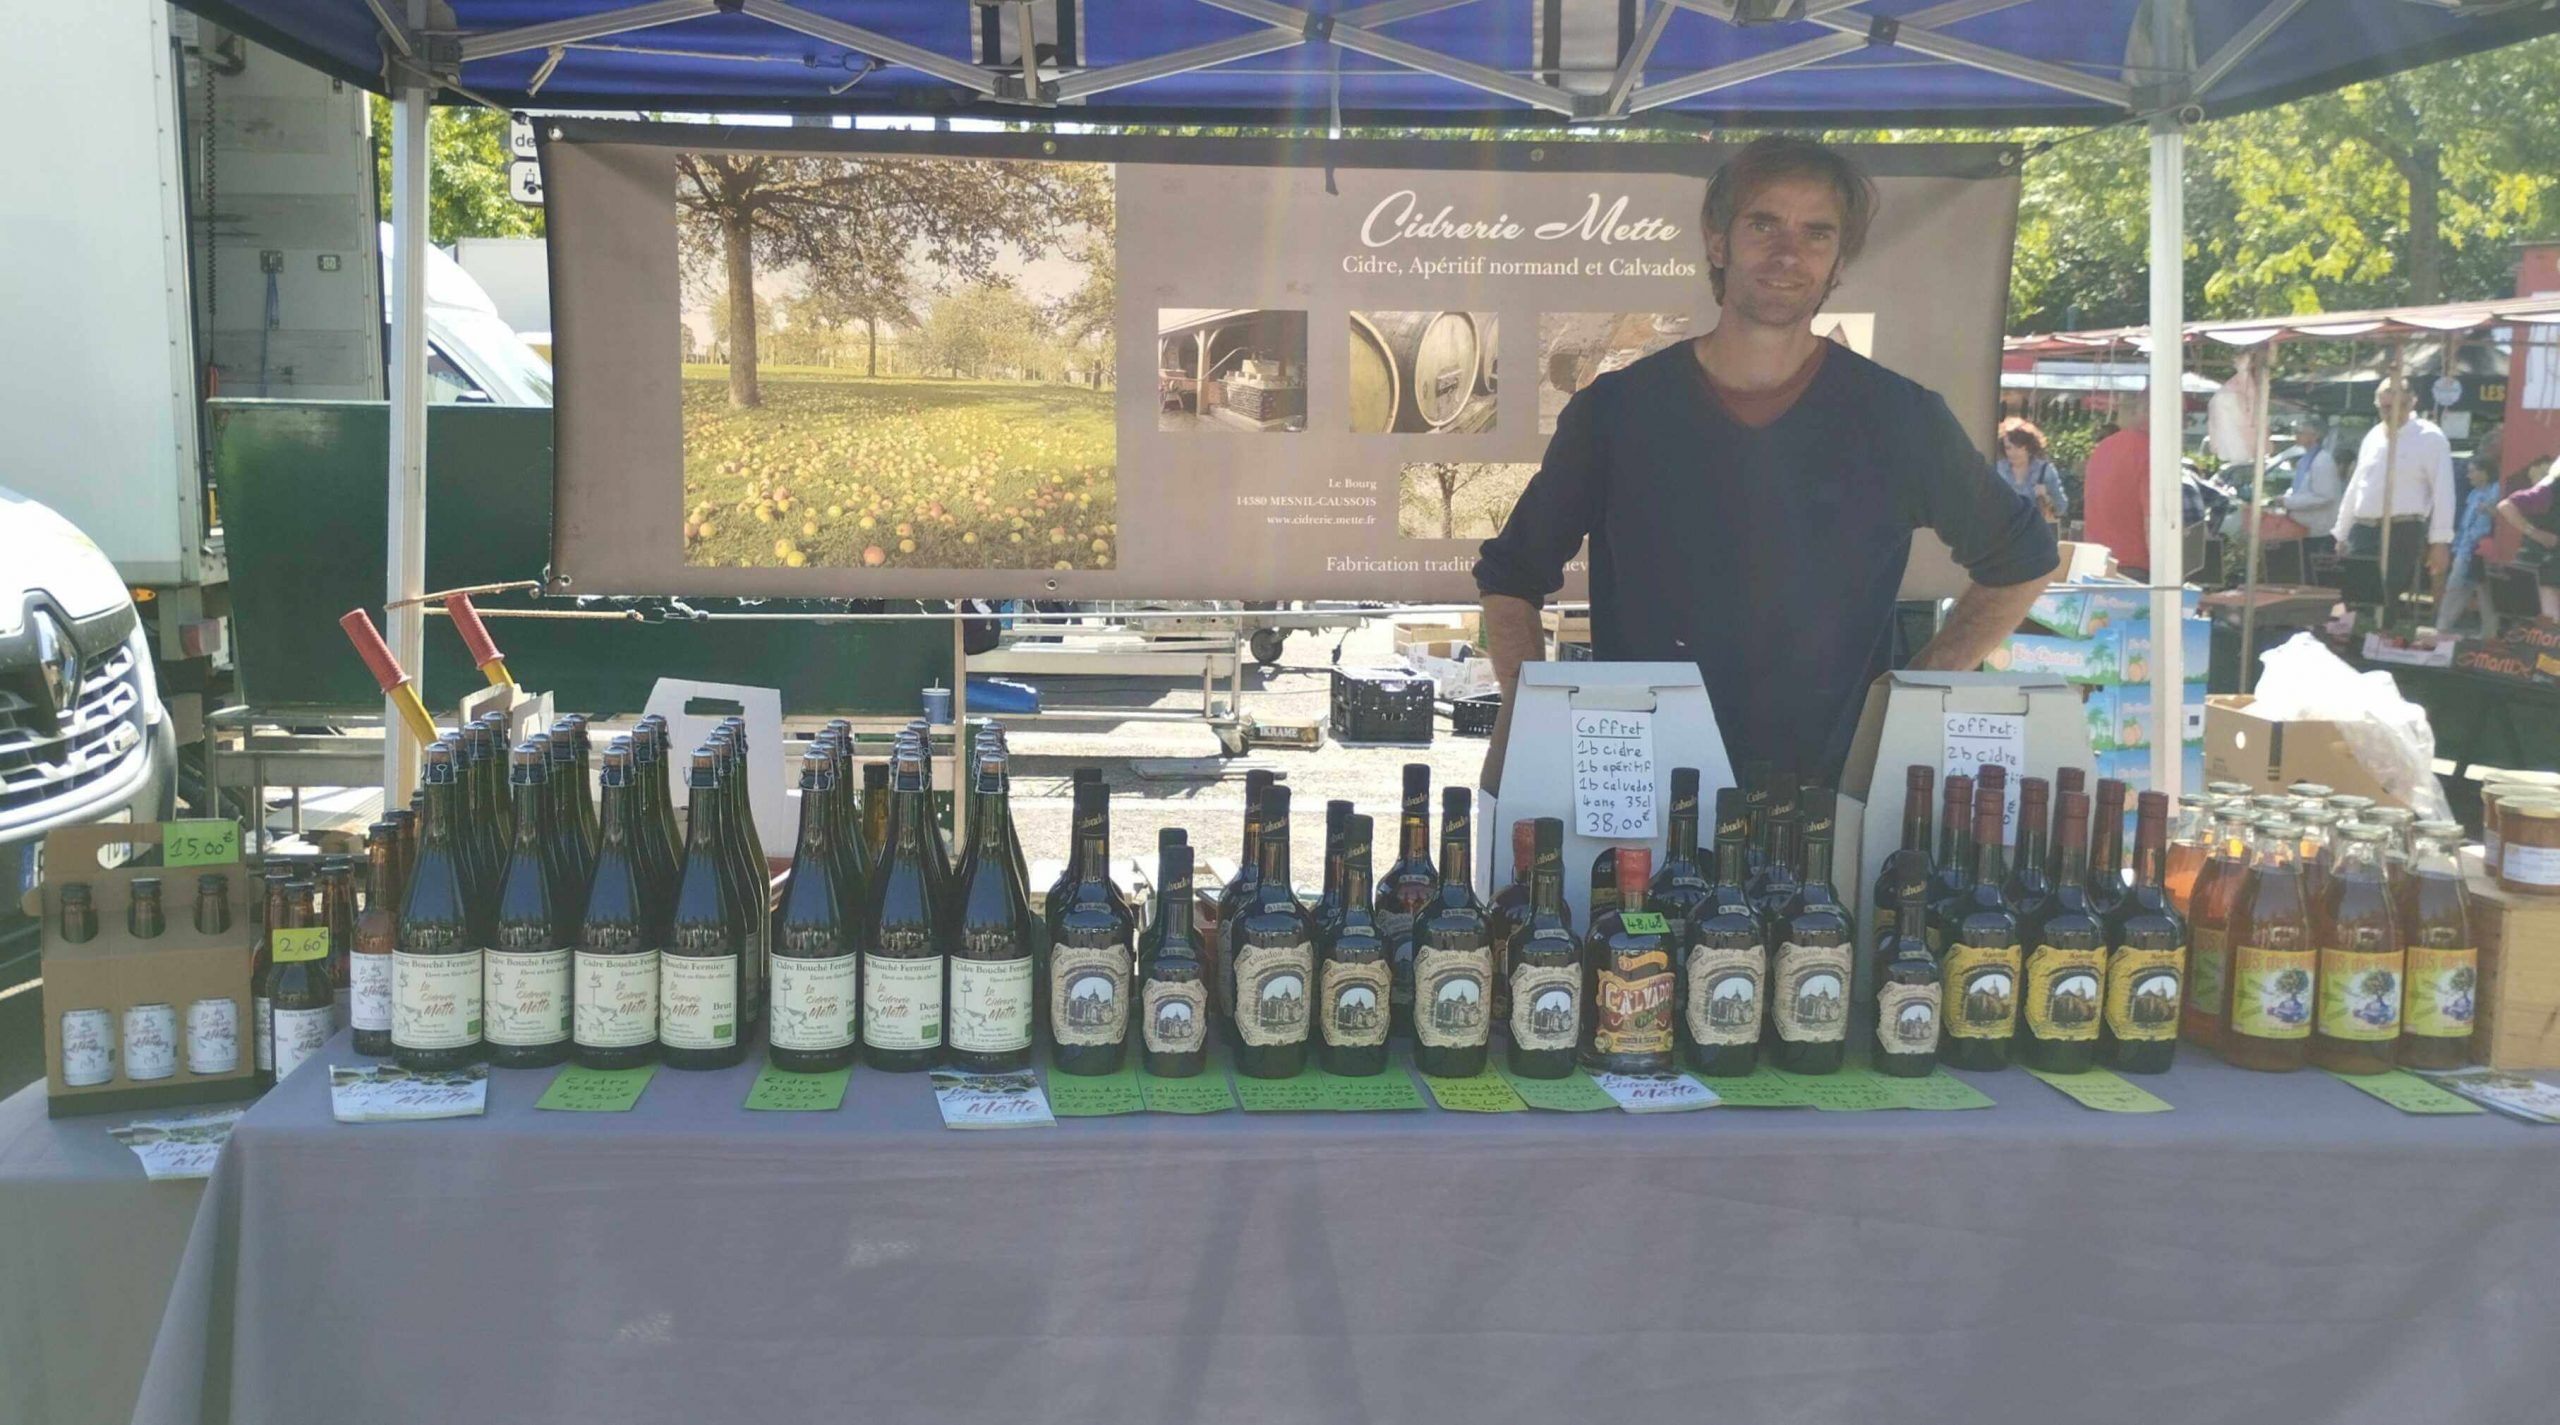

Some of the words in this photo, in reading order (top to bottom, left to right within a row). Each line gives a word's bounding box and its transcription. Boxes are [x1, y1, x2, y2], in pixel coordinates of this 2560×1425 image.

[1360, 189, 1526, 247] Cidrerie
[1534, 192, 1682, 245] Mette
[1342, 255, 1403, 277] Cidre,
[1409, 255, 1485, 279] Apéritif
[1489, 257, 1579, 276] normand
[1585, 260, 1604, 276] et
[1609, 257, 1696, 277] Calvados
[1328, 478, 1342, 488] Le
[1345, 478, 1377, 491] Bourg
[1326, 556, 1420, 573] Fabrication
[1424, 556, 1475, 573] traditi
[1259, 727, 1298, 738] IKRAME
[1576, 717, 1644, 735] Coffret
[1577, 740, 1598, 755] 1b
[1603, 741, 1642, 757] cidre
[1947, 747, 1972, 760] 2b
[1975, 746, 2016, 765] cidre
[1577, 760, 1598, 773] 1b
[1579, 777, 1599, 790] 1b
[1603, 778, 1654, 792] calvados
[170, 831, 236, 859] 15,00€
[280, 931, 327, 956] 2,60€
